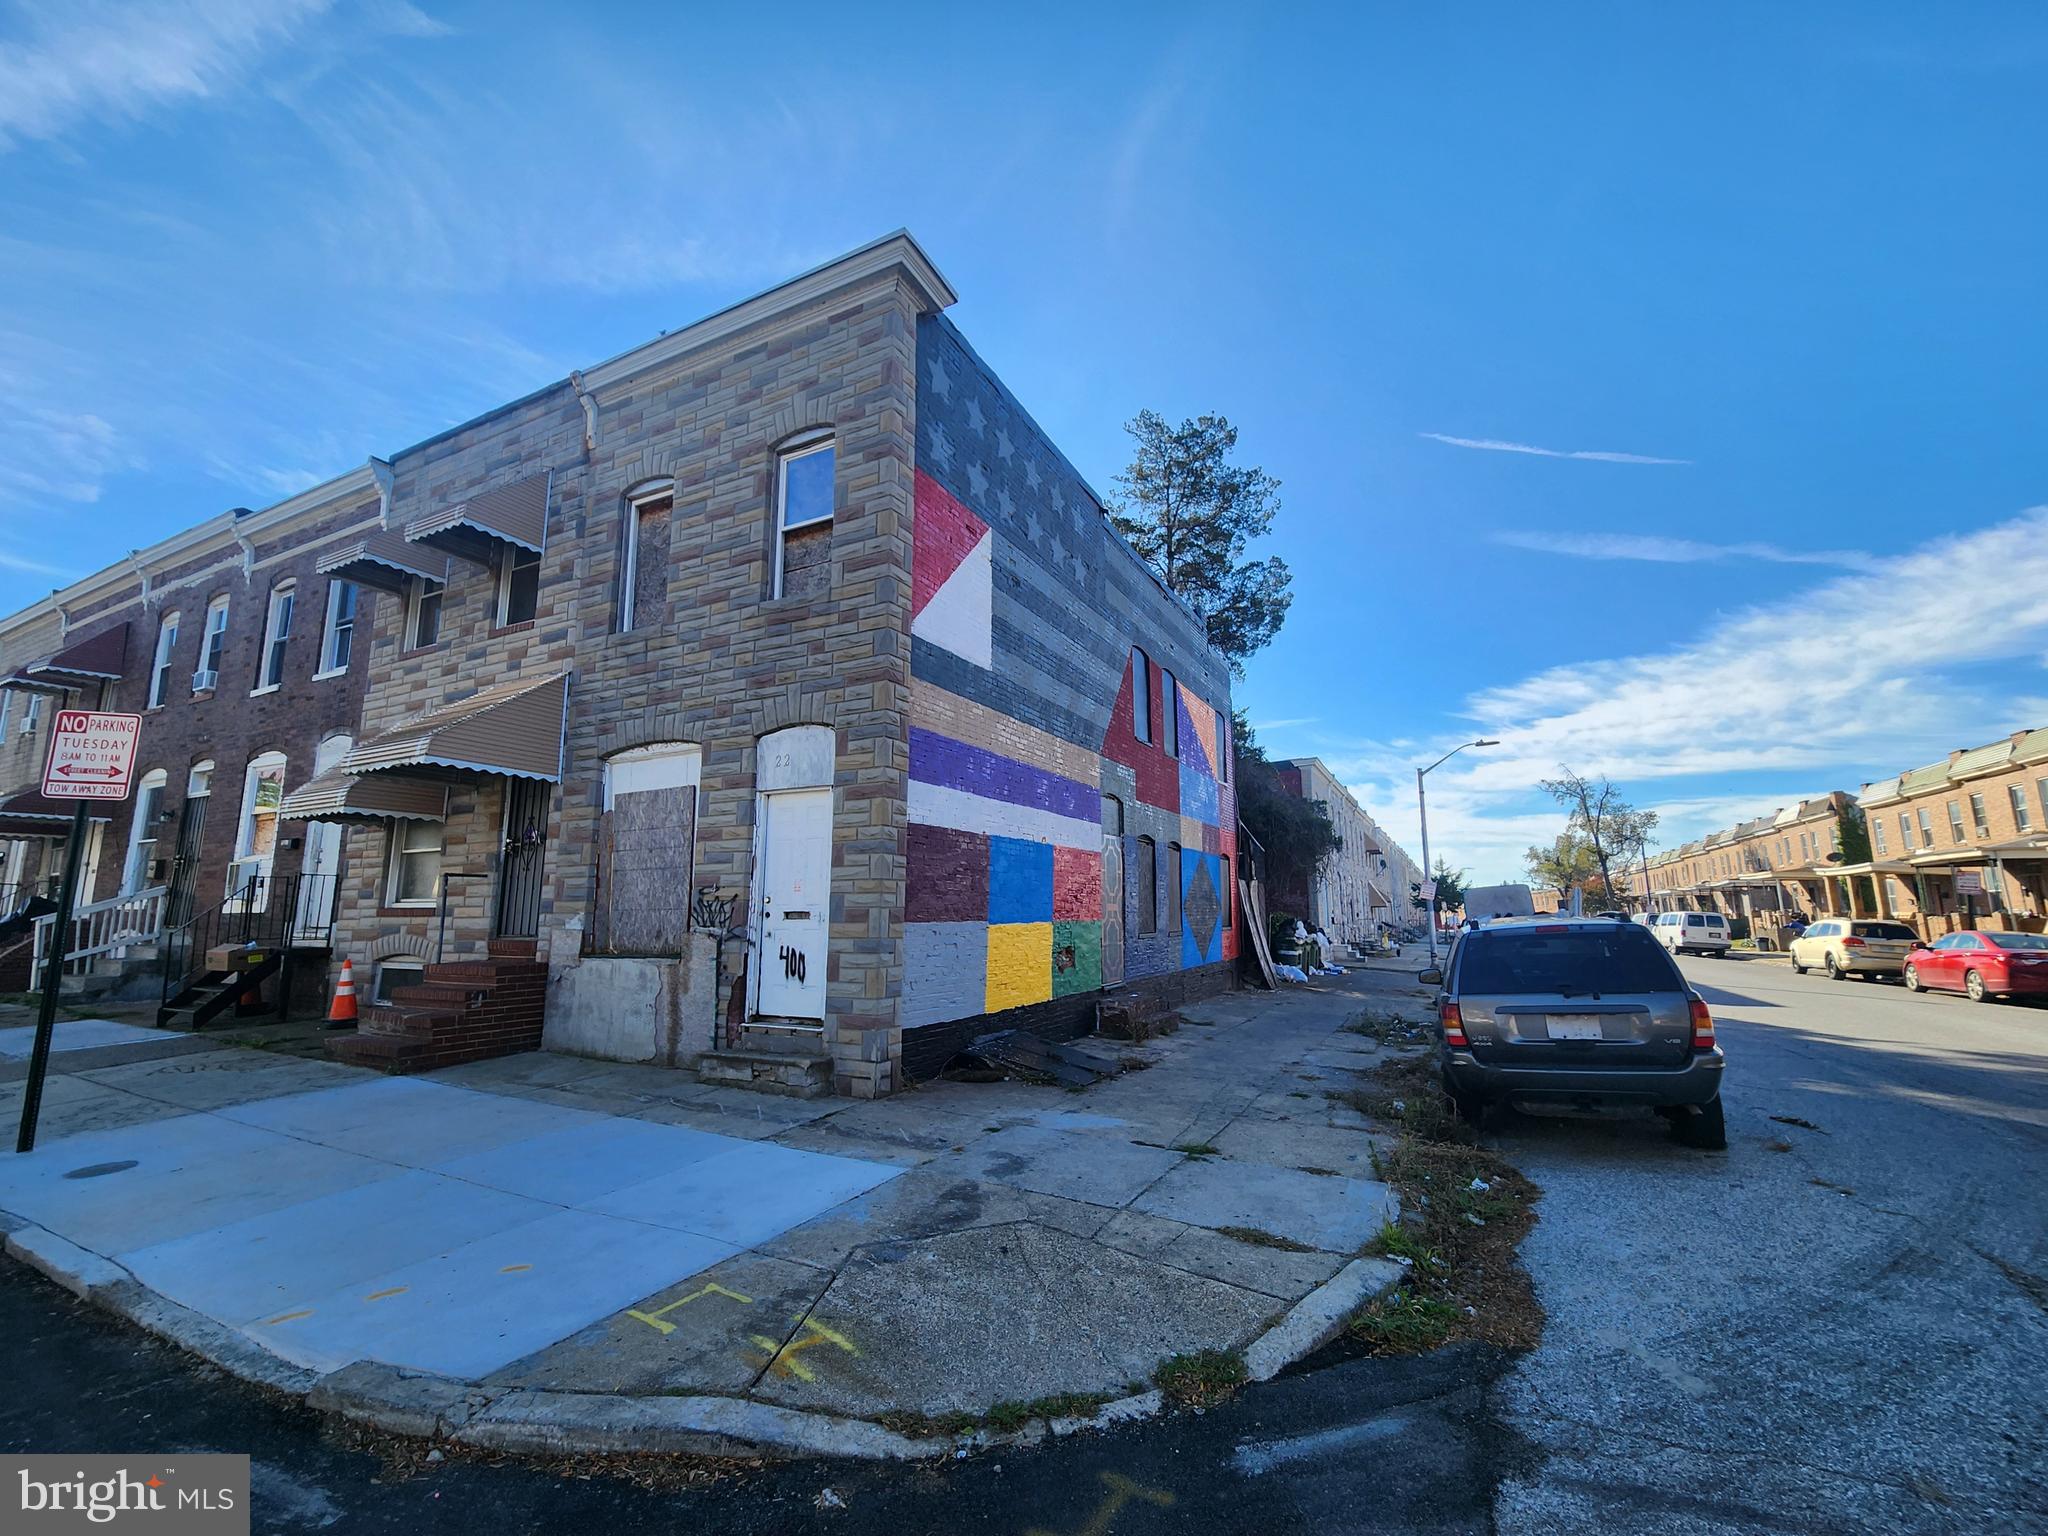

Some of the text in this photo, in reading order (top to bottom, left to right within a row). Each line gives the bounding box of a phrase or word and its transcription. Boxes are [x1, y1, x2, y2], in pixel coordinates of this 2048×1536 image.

[60, 715, 134, 732] NO PARKING
[63, 737, 128, 750] TUESDAY
[85, 753, 96, 762] TO
[49, 783, 124, 795] TOW AWAY ZONE
[779, 945, 806, 985] 400
